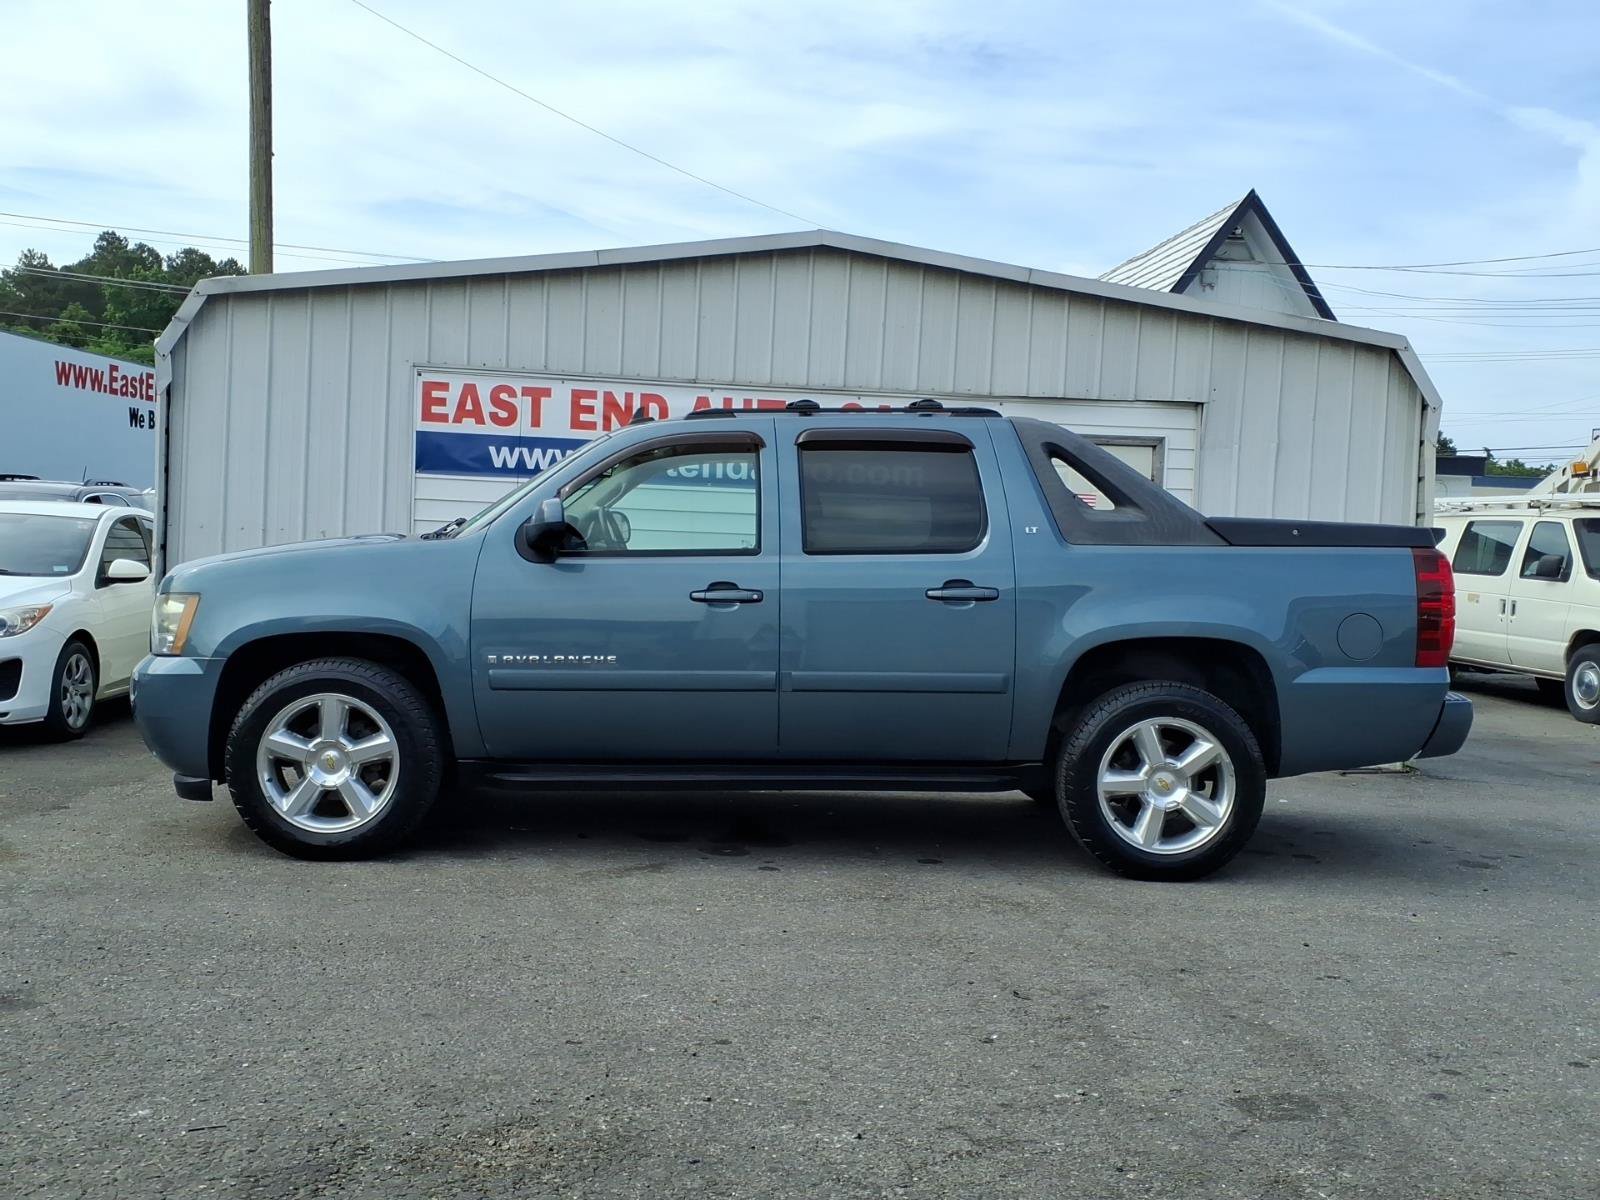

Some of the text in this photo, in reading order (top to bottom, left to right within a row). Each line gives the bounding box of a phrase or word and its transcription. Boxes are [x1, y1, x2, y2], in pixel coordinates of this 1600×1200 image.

[54, 360, 156, 402] www.EastE
[420, 381, 552, 429] EAST
[129, 407, 145, 429] We
[1025, 526, 1039, 534] LT
[502, 655, 617, 664] AVALANCHE
